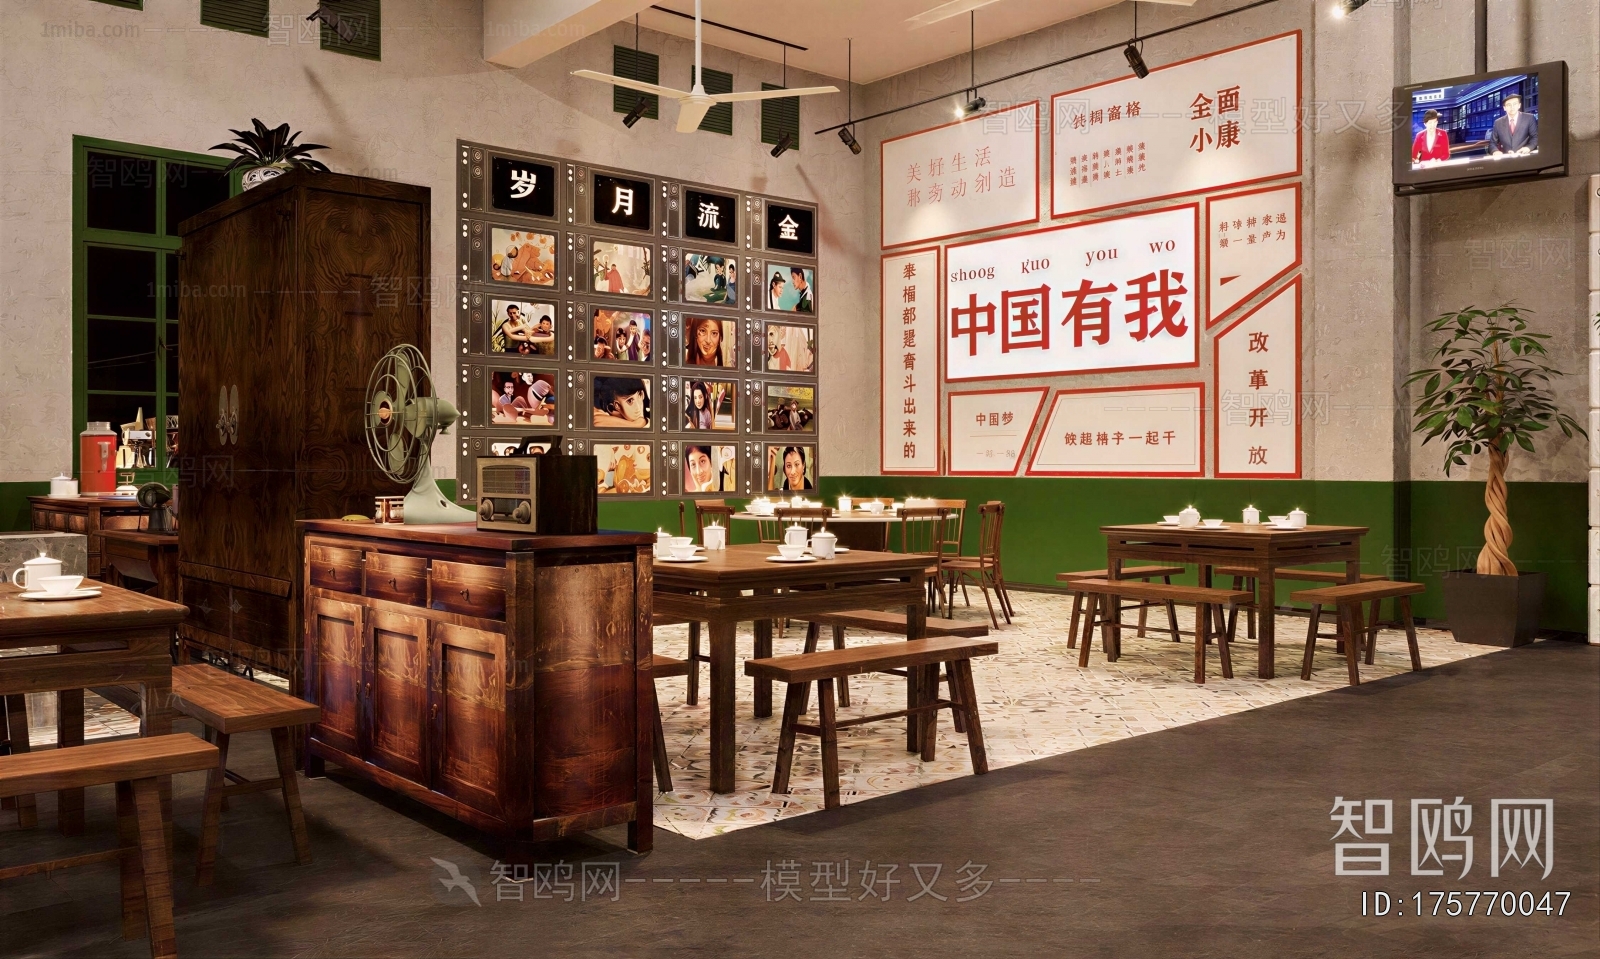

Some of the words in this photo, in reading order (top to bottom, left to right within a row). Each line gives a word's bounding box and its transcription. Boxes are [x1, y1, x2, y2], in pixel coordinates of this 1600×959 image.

[1085, 248, 1119, 267] you
[1149, 239, 1176, 254] wo
[951, 268, 1189, 357] 中国有我
